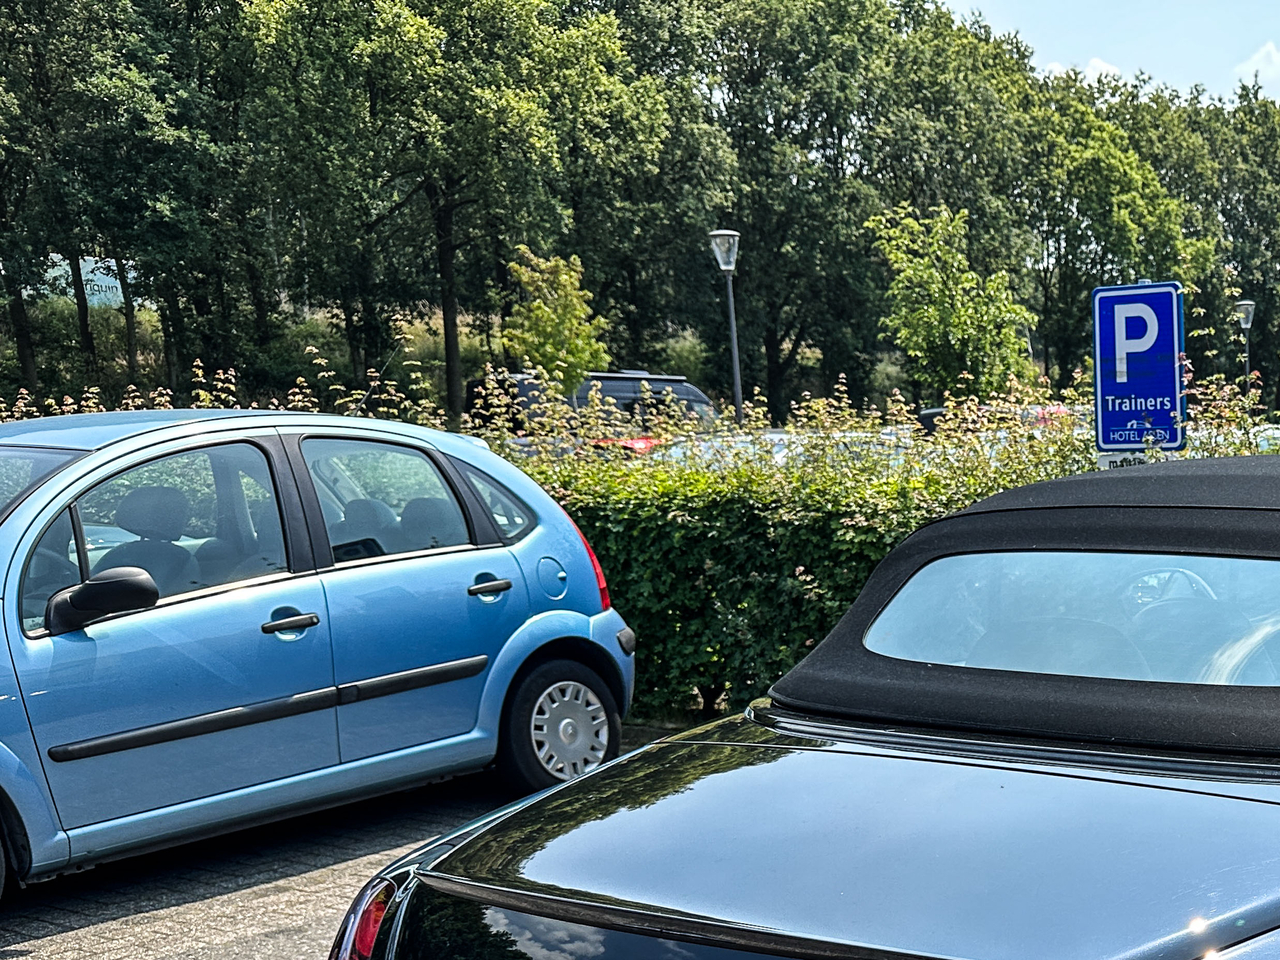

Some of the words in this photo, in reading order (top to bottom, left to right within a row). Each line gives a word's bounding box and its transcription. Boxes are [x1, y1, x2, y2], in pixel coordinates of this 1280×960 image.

[1114, 303, 1159, 383] P
[1105, 395, 1171, 412] Trainers
[1110, 431, 1140, 441] HOTEL
